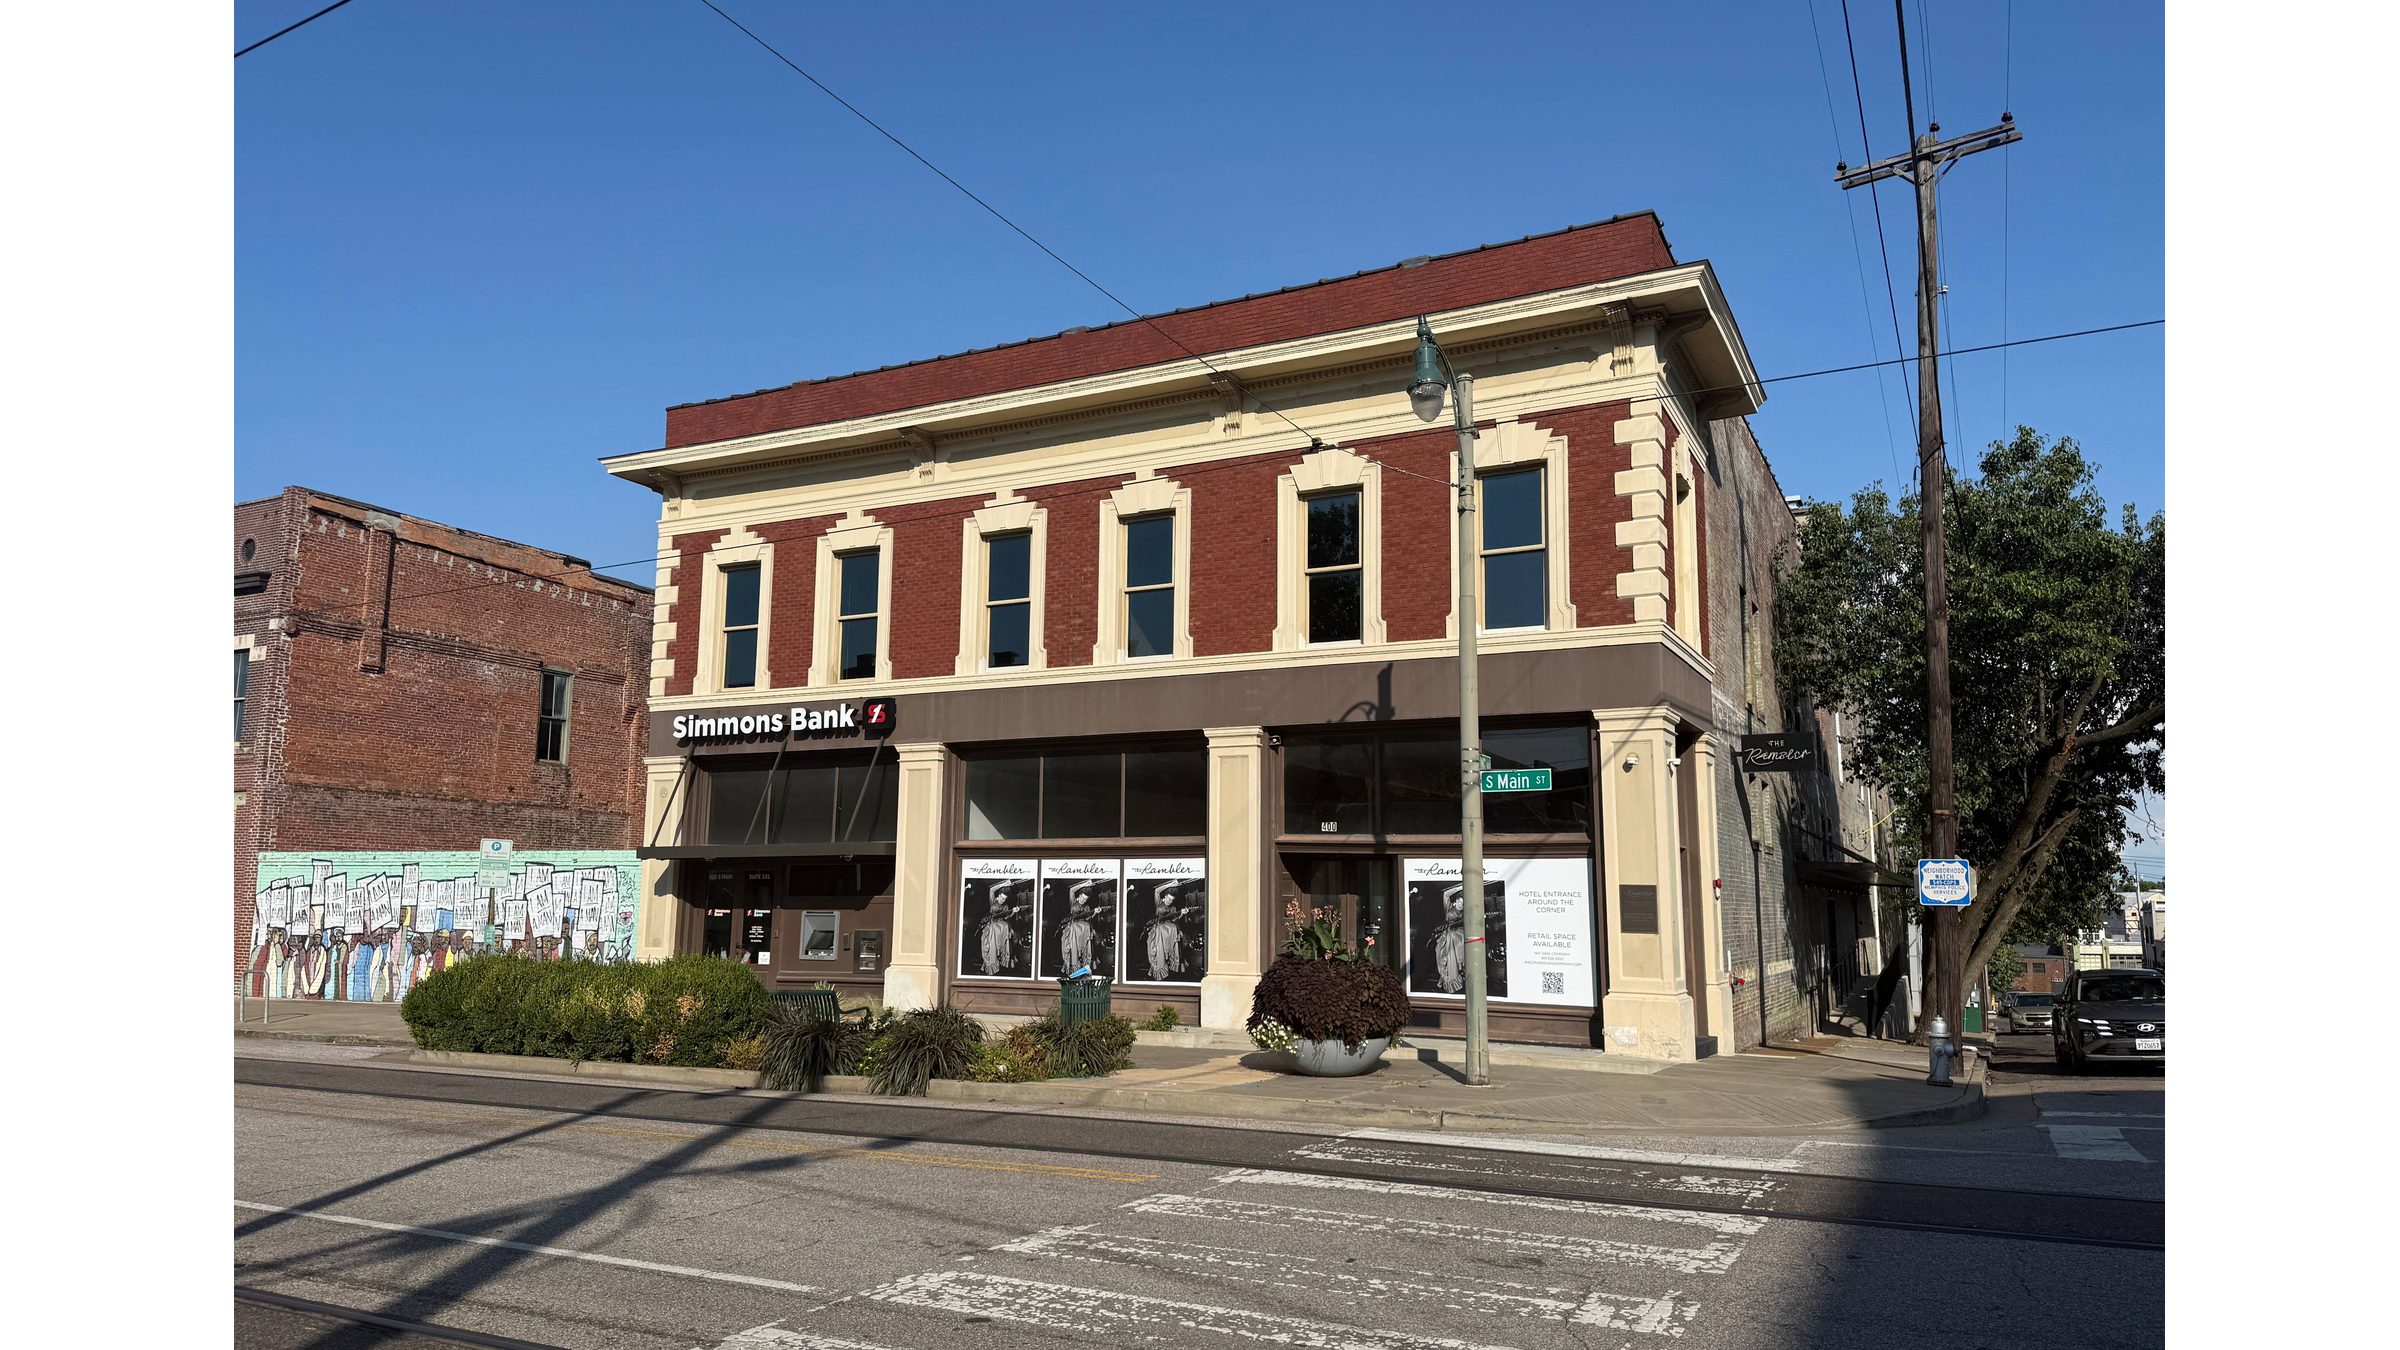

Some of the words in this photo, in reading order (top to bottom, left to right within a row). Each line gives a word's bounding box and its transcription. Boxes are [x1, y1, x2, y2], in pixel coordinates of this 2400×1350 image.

[672, 714, 784, 739] Simmons
[791, 703, 854, 731] Bank
[1766, 739, 1785, 748] THE
[1744, 747, 1812, 766] Rambler
[1485, 775, 1493, 789] S
[1497, 772, 1530, 789] Main
[1535, 775, 1546, 785] ST
[977, 862, 1031, 876] Rambler
[1056, 862, 1113, 875] Rambler
[1140, 862, 1200, 875] Rambler
[1518, 890, 1543, 898] HOTEL
[1543, 890, 1583, 898] ENTRANCE
[1527, 898, 1559, 906] AROUND
[1535, 906, 1566, 914] CORNER
[1527, 932, 1552, 940] RETAIL
[1553, 933, 1576, 941] SPACE
[1532, 941, 1572, 949] AVAILABLE
